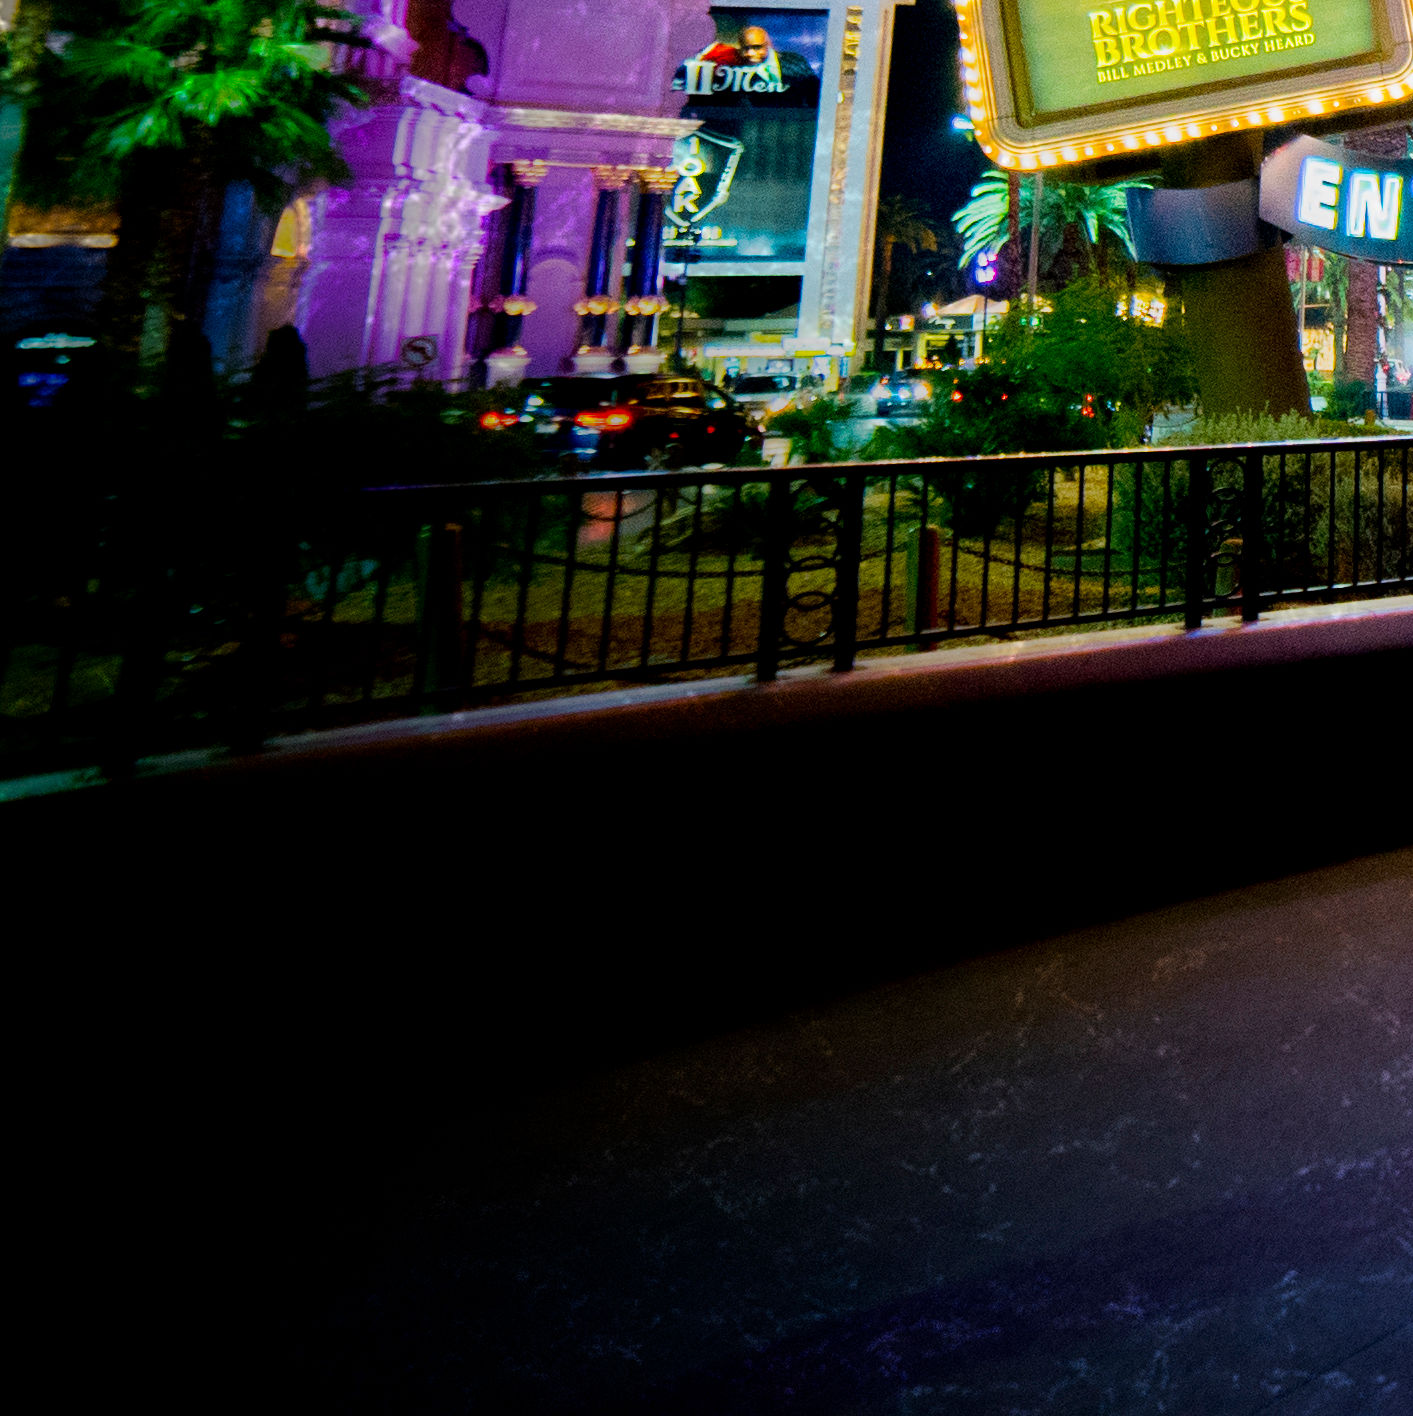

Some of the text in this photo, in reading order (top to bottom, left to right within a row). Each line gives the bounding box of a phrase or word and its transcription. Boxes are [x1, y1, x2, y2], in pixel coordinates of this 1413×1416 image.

[1092, 2, 1314, 69] BROTHERS
[1096, 31, 1316, 83] BILL MEDLEY & BUCKY HEARD
[684, 59, 791, 95] II Men
